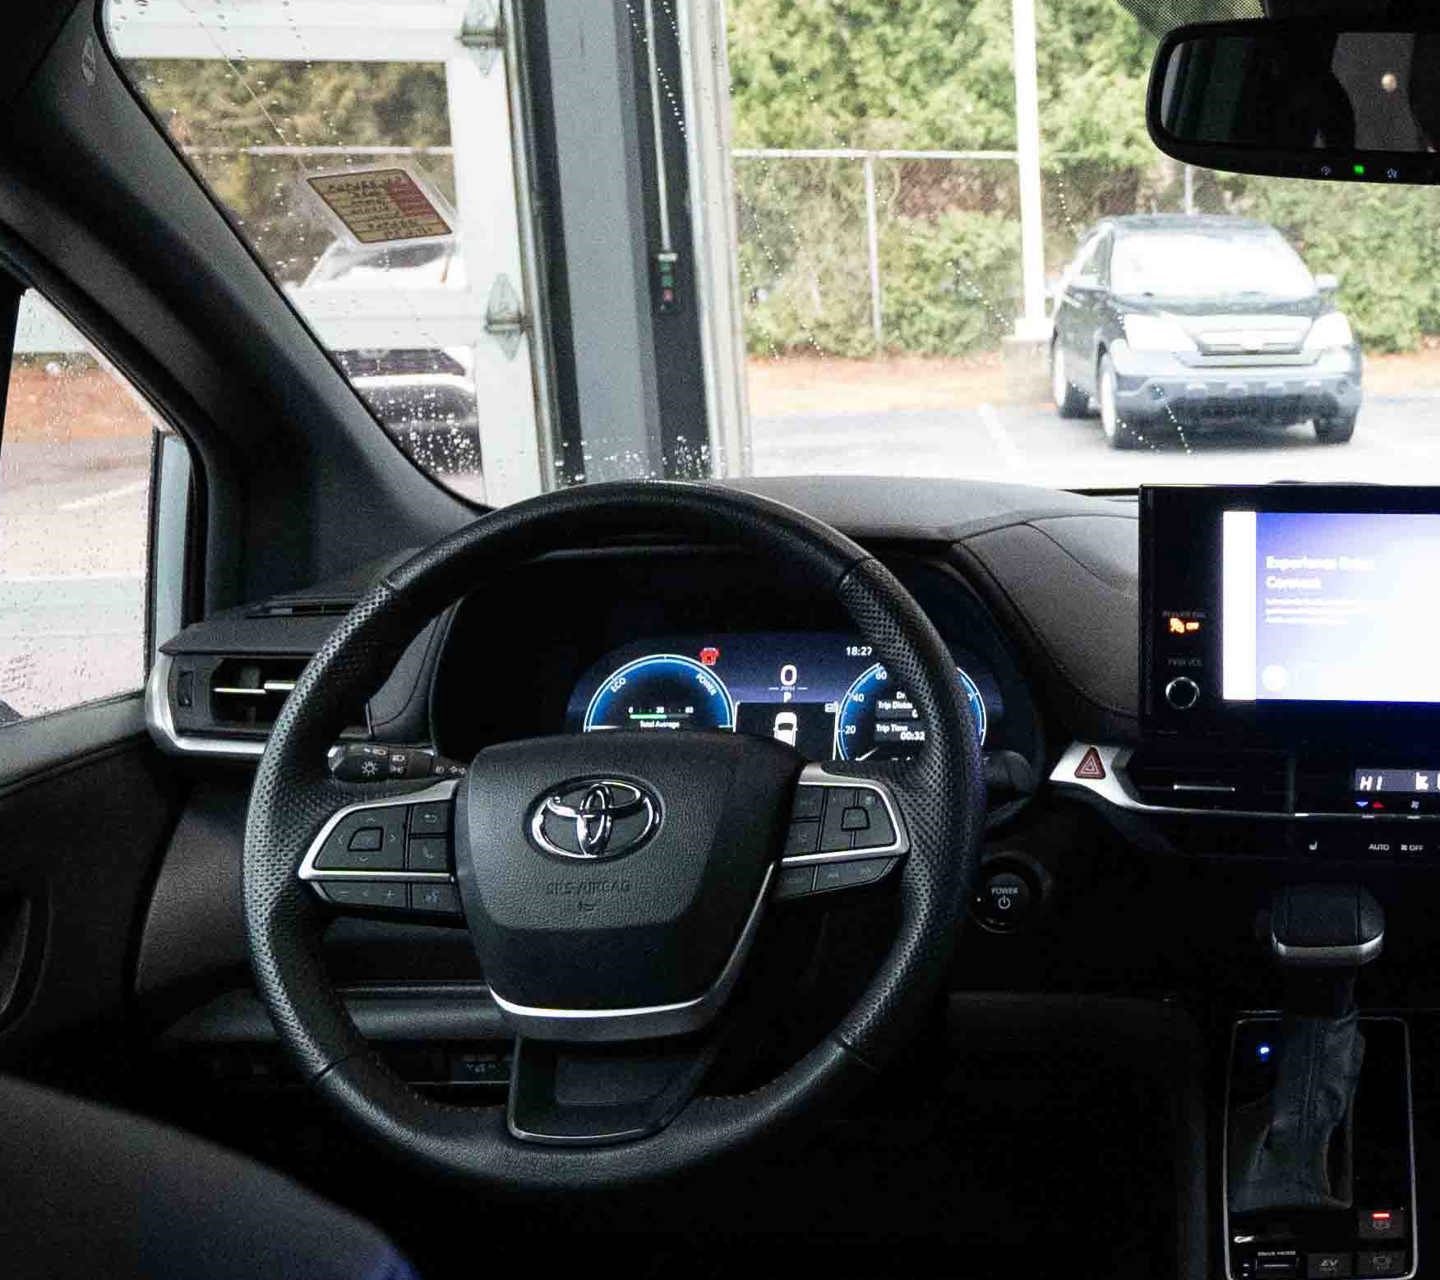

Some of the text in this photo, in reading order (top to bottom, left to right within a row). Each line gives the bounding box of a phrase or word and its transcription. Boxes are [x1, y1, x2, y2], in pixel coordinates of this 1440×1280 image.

[846, 646, 873, 657] 18:27
[780, 664, 798, 687] 0
[852, 693, 865, 703] 40
[844, 724, 857, 735] 20
[876, 723, 890, 733] Trip
[1368, 843, 1391, 852] AUTO
[1408, 844, 1424, 852] OFF
[990, 886, 1019, 895] POWER
